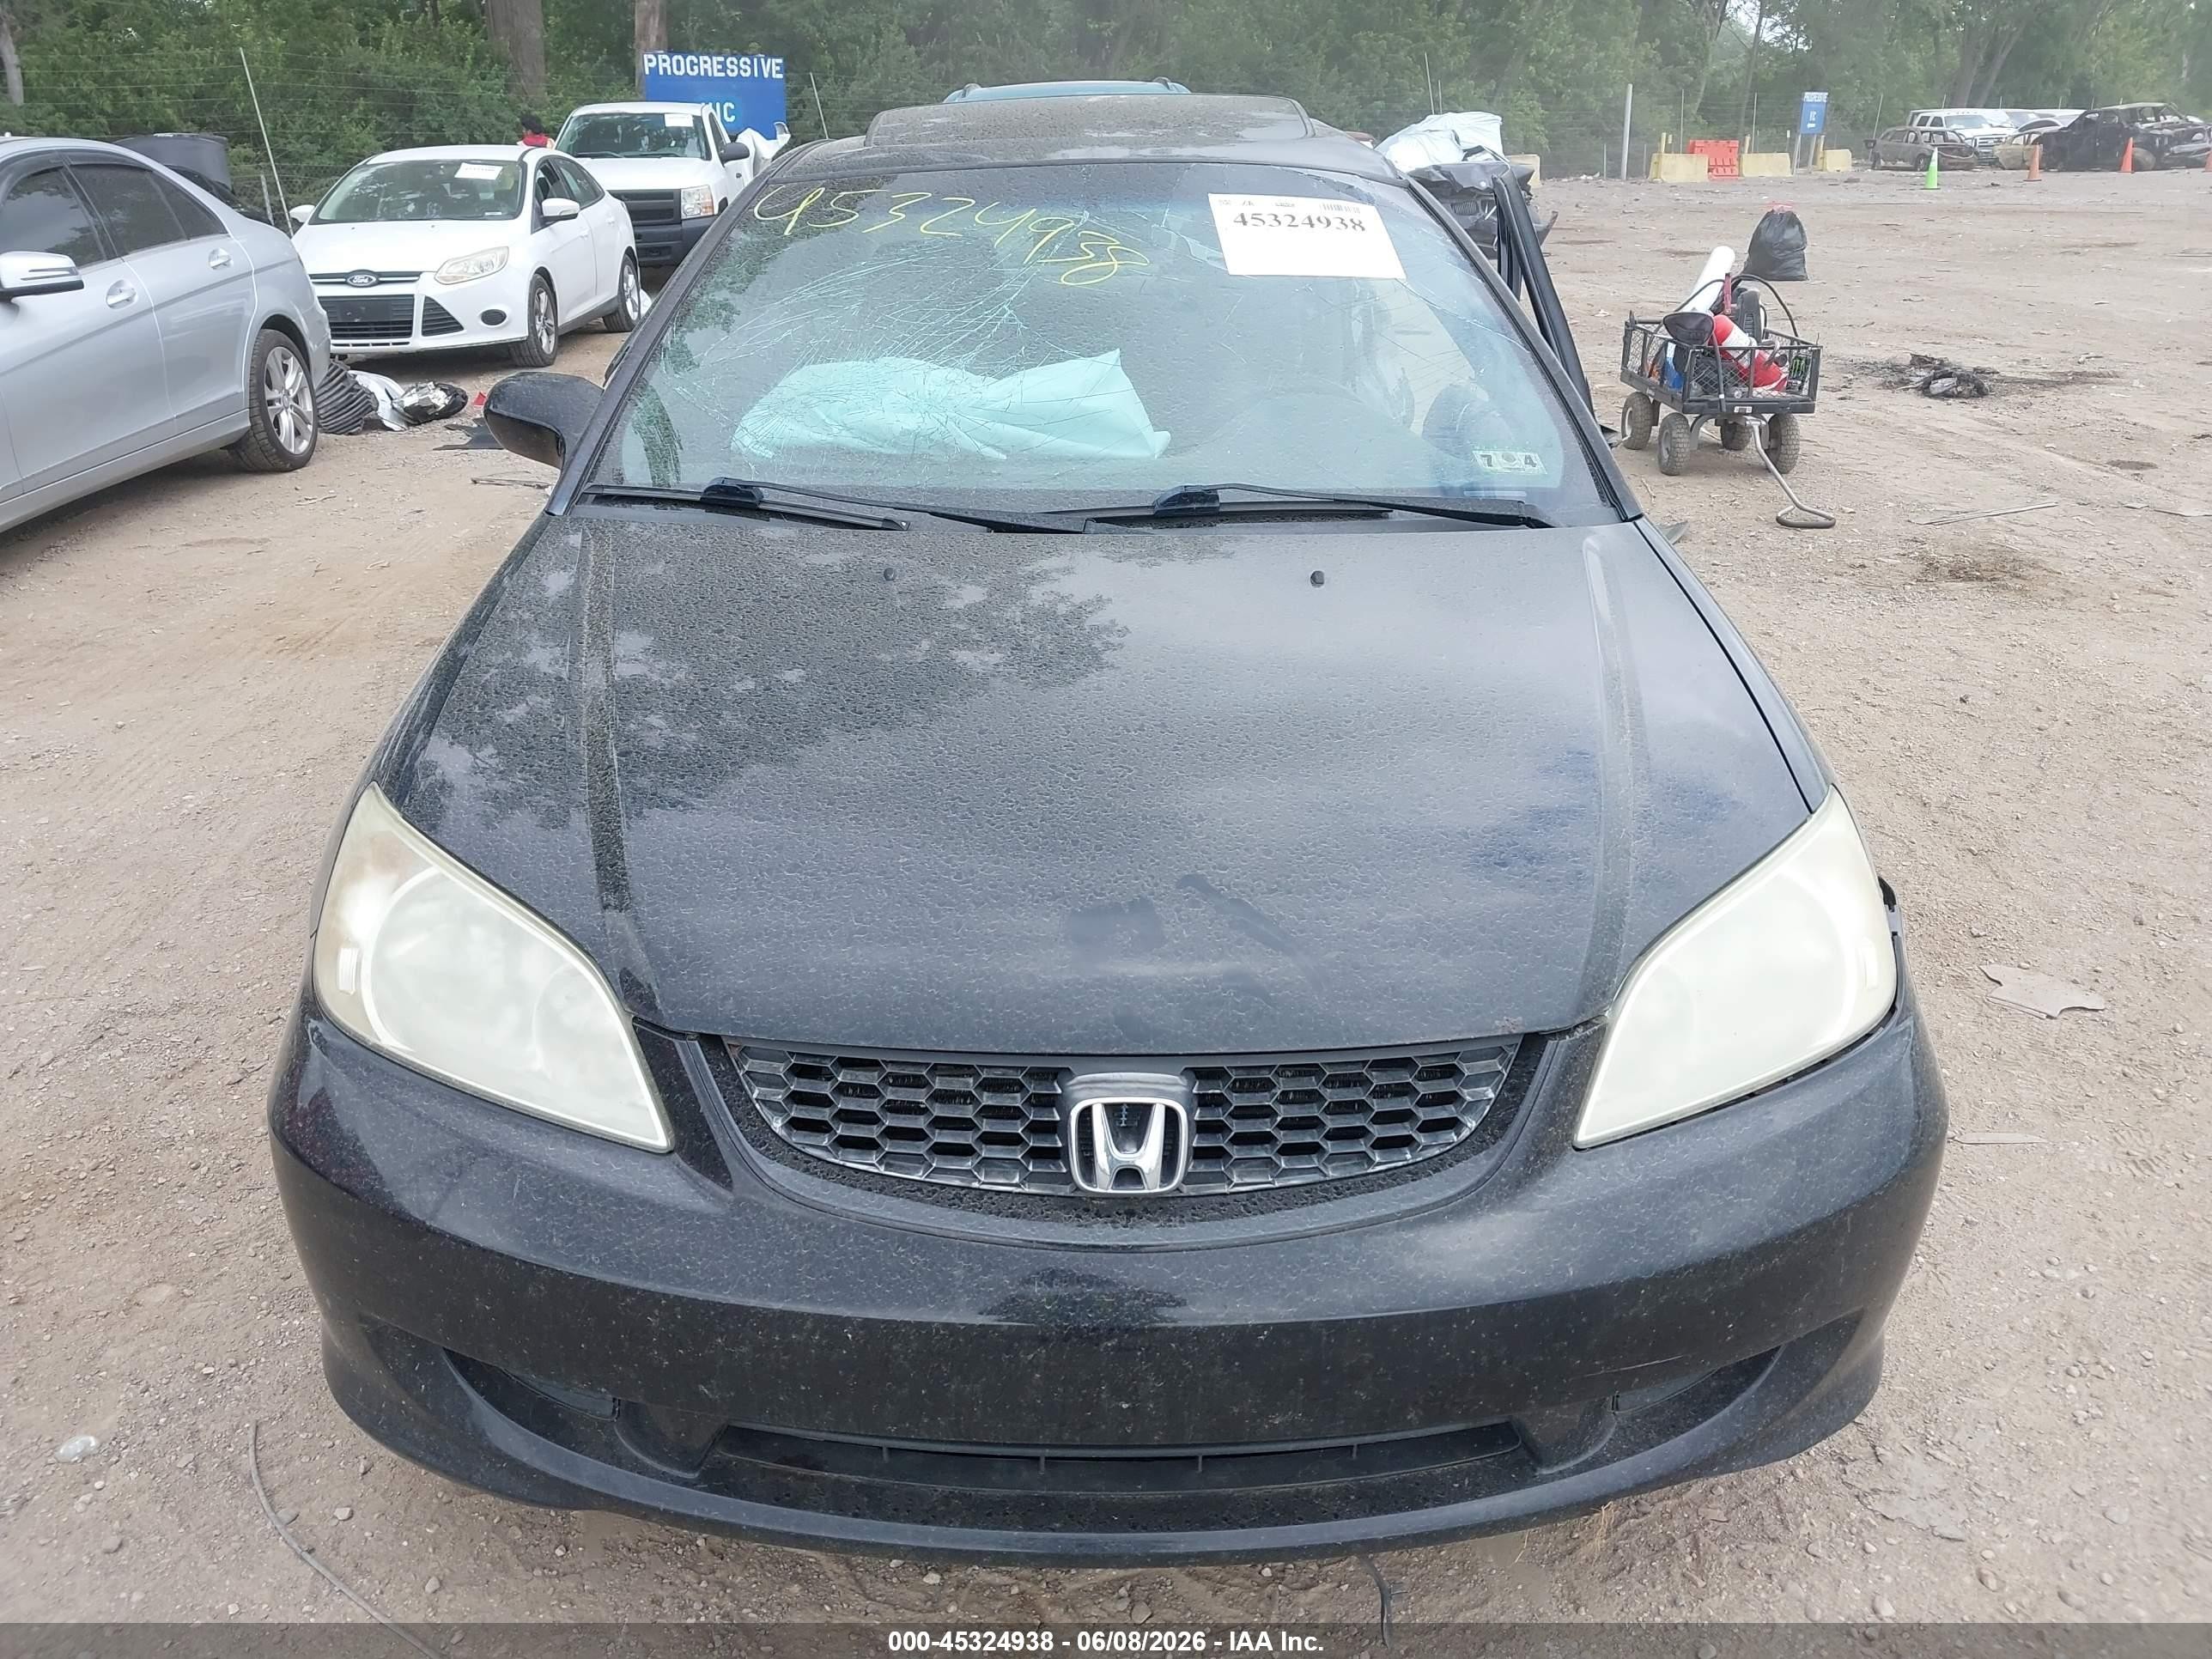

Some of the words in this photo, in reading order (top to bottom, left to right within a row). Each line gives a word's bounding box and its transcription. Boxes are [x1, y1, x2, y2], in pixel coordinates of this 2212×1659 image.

[643, 54, 784, 79] PROGRESSIVE
[1233, 212, 1366, 232] 45324938
[753, 184, 1150, 286] 45324938
